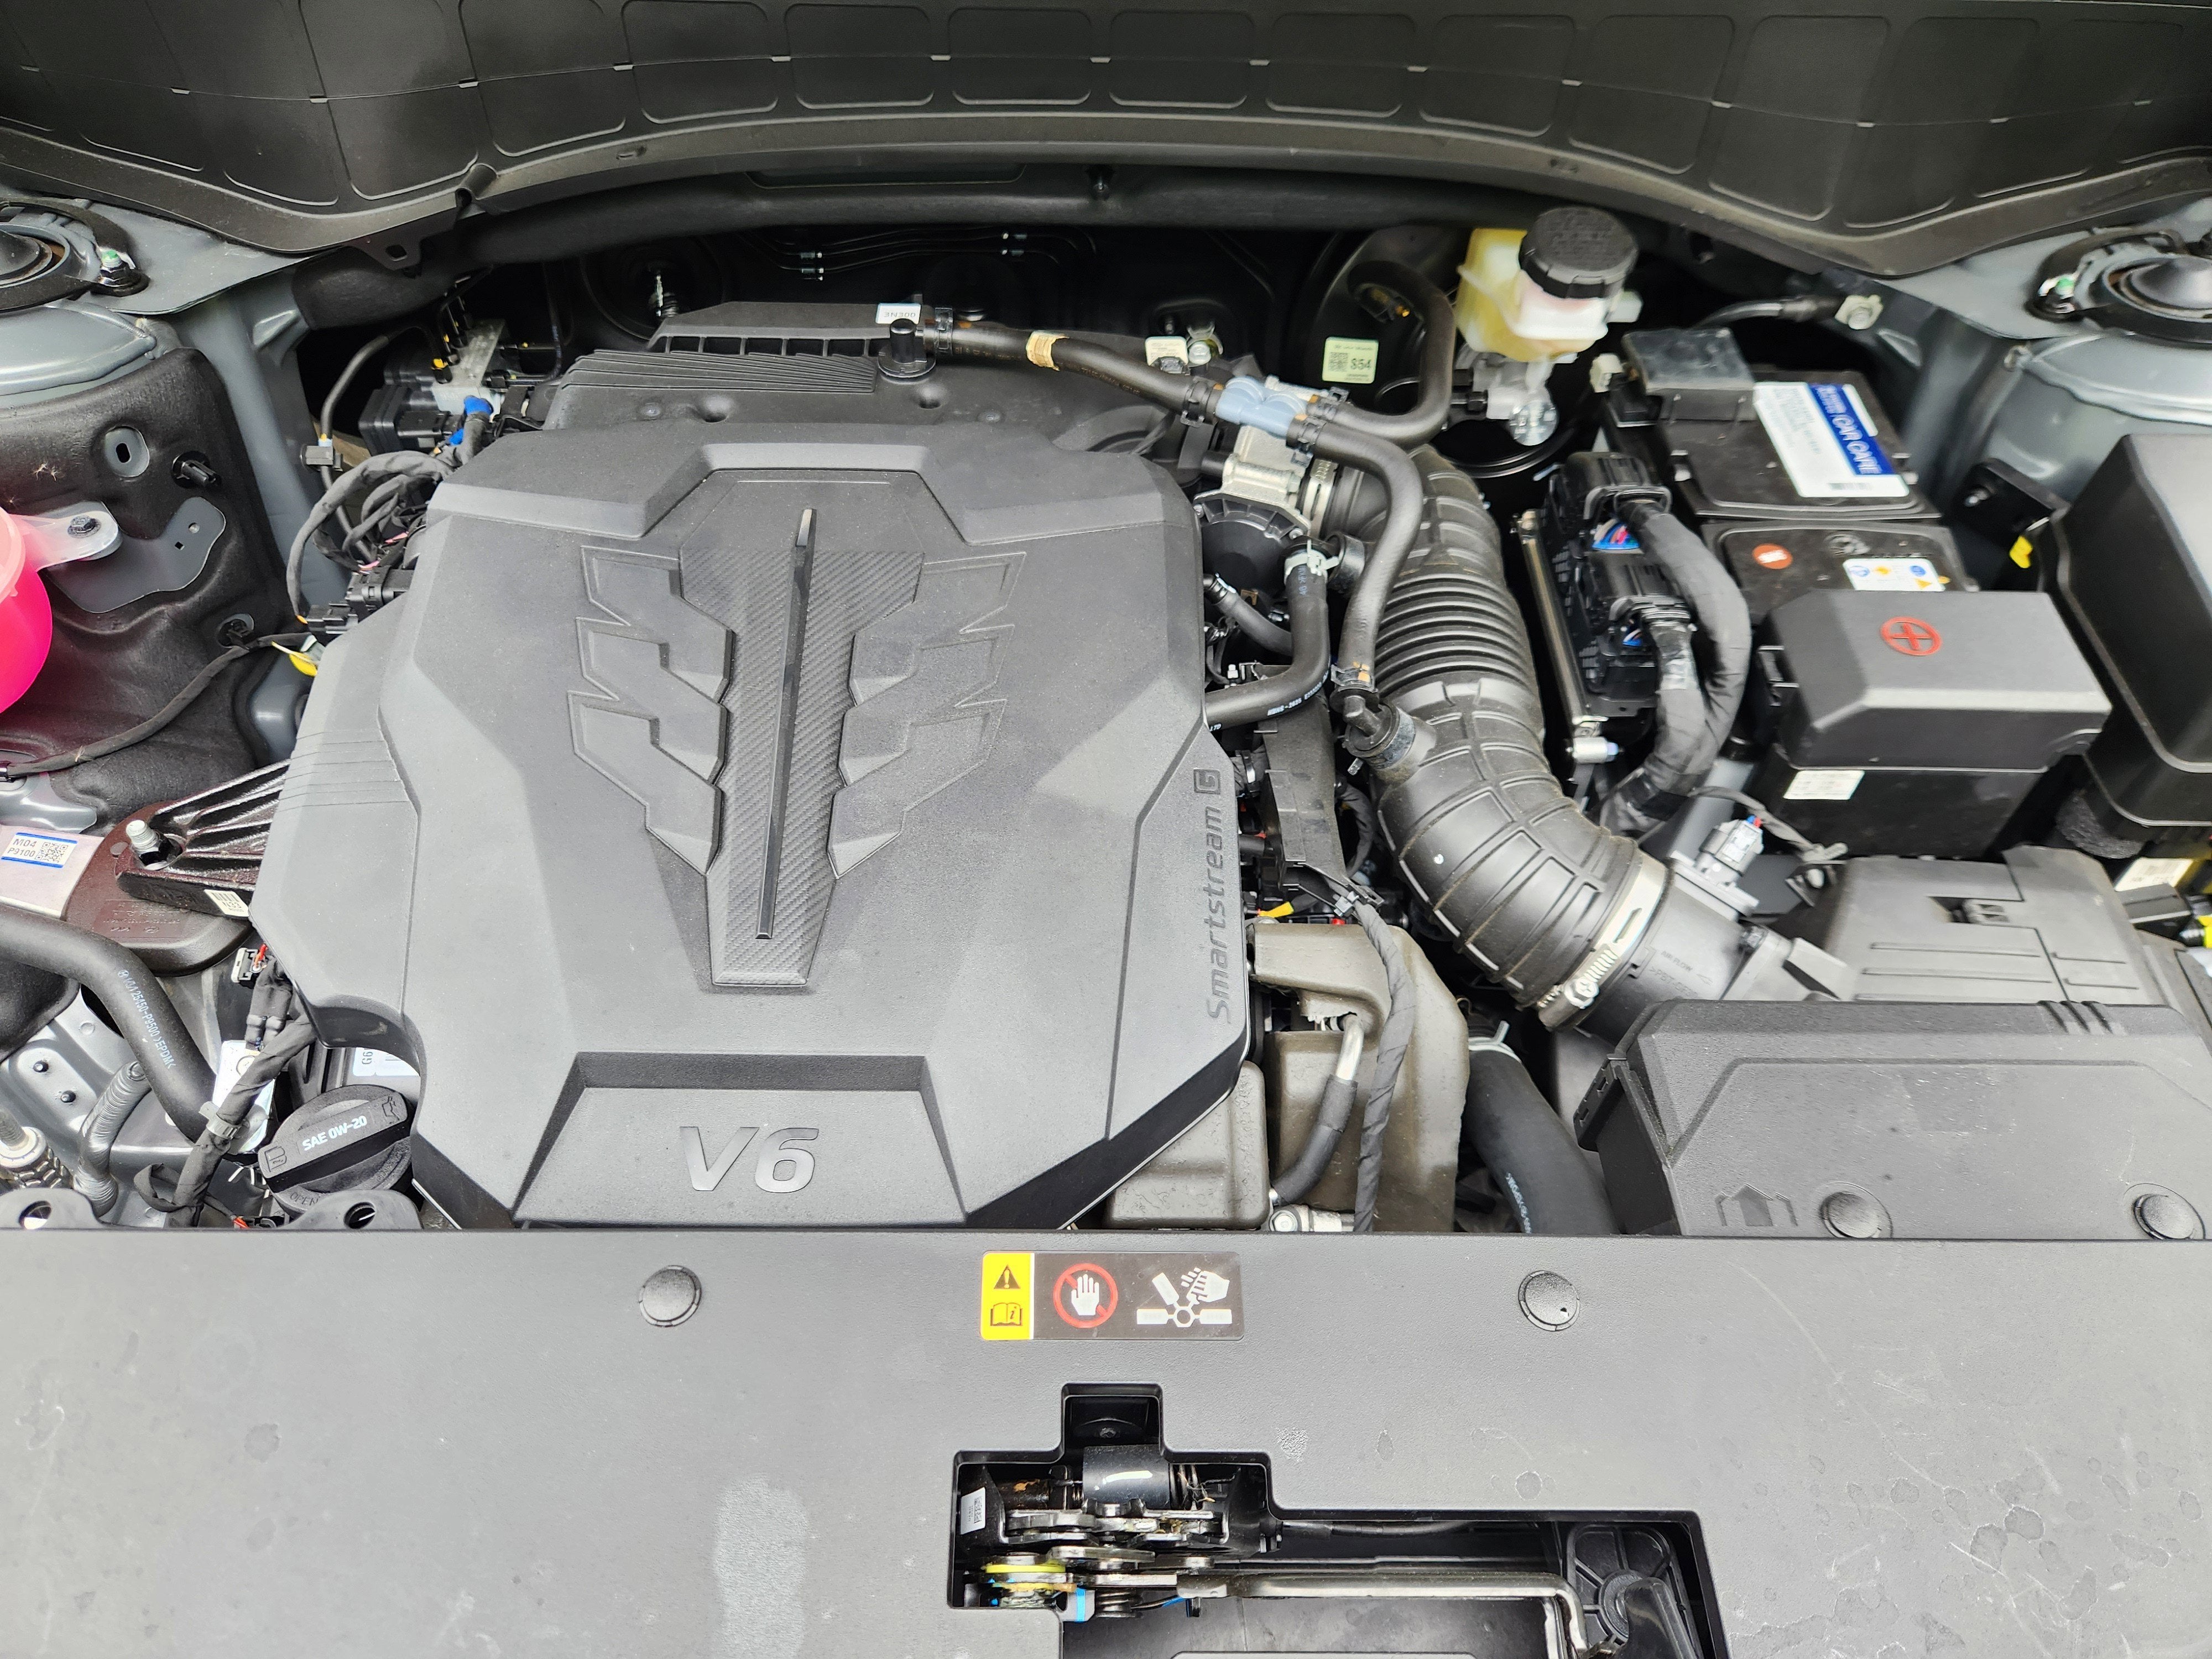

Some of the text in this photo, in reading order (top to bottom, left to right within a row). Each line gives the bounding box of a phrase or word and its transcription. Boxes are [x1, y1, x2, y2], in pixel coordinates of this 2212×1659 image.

[7, 847, 36, 857] P9100
[13, 839, 37, 848] M04
[1203, 806, 1231, 1024] Smartstream
[131, 990, 160, 1037] 25450-P9500
[361, 1047, 374, 1065] G6
[302, 1115, 367, 1151] SAE 0W-20
[679, 1126, 819, 1193] V6
[290, 1192, 319, 1206] OPEN
